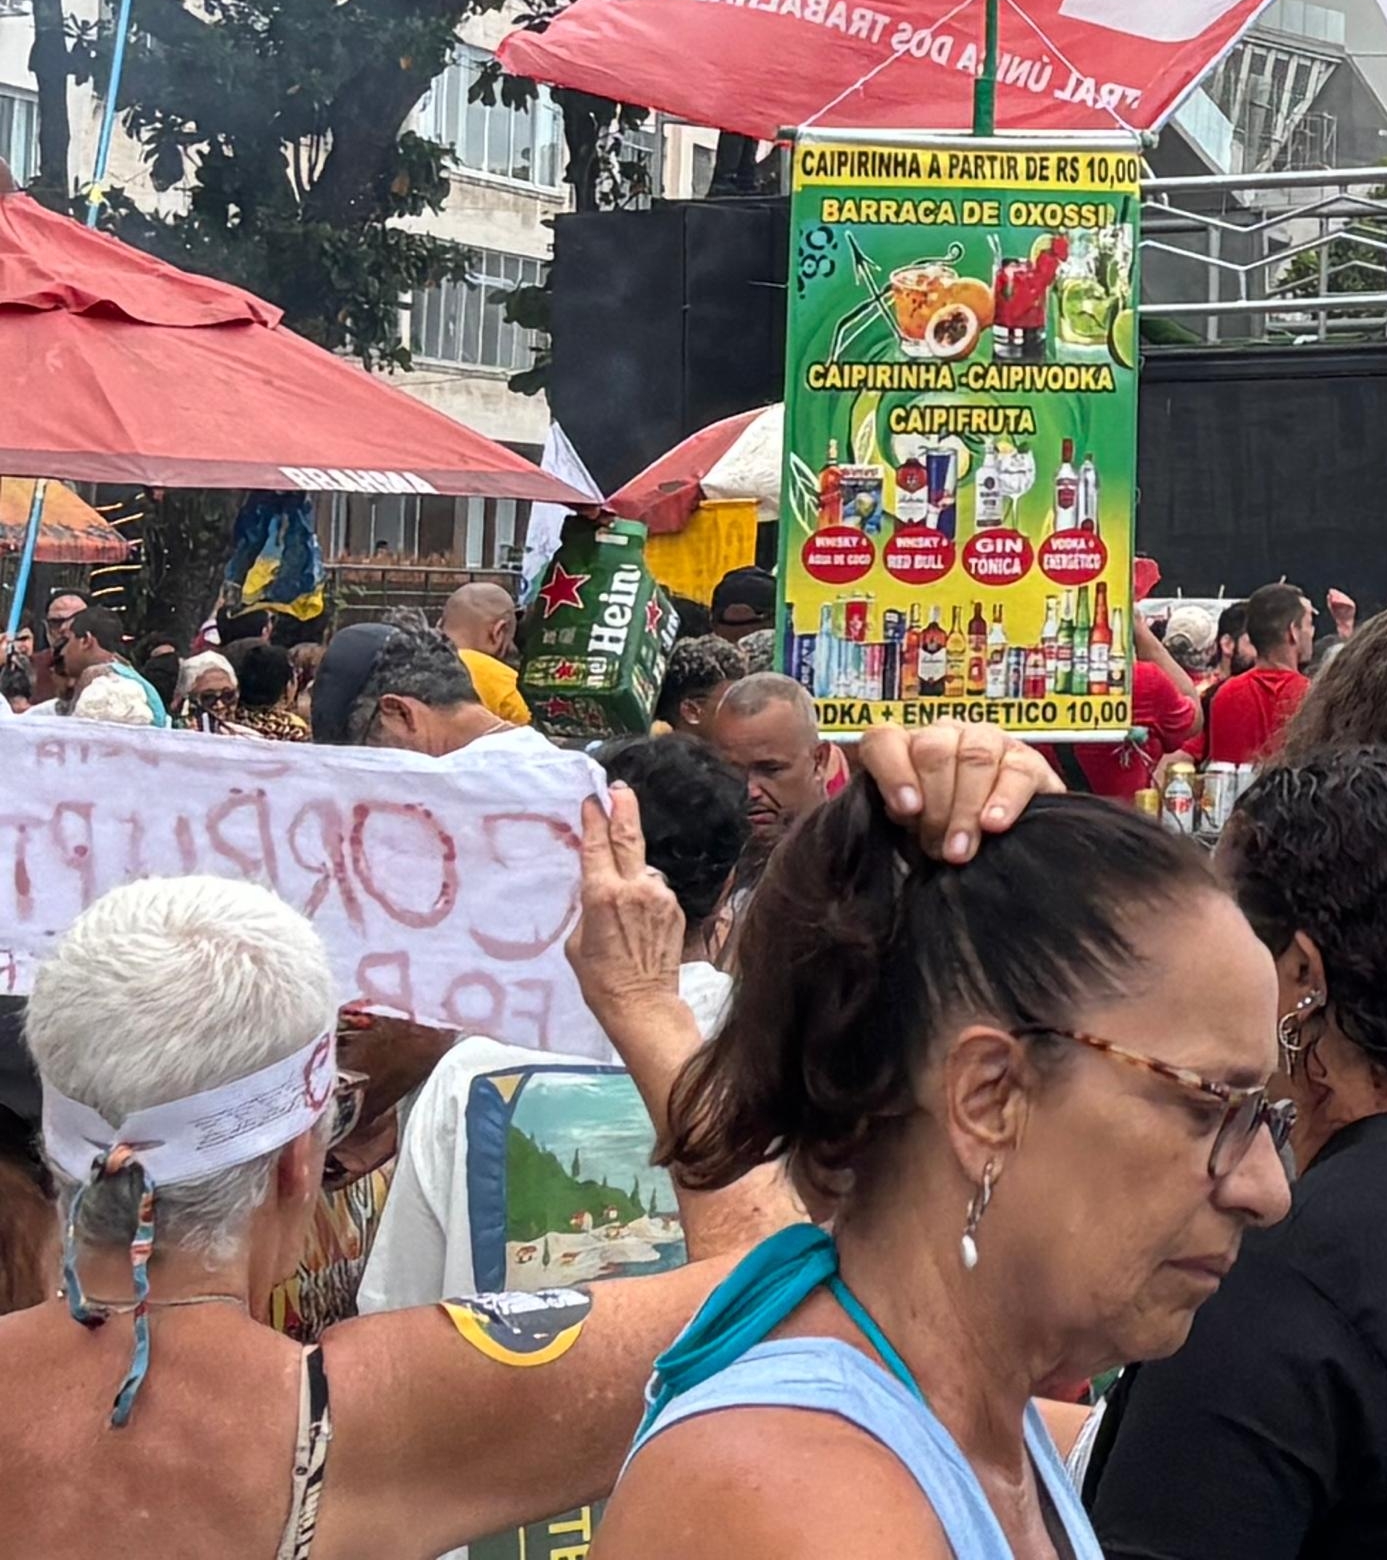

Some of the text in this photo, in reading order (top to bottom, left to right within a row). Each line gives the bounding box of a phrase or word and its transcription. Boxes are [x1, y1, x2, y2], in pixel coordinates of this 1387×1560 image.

[801, 150, 919, 180] CAIPIRINHA
[927, 155, 943, 180] A
[949, 153, 1019, 182] PARTIR
[1025, 156, 1050, 181] DE
[1086, 157, 1137, 190] 10,00
[821, 198, 1111, 228] BARRACA DE OXOSSI
[807, 362, 956, 391] CAIPIRINHA
[889, 405, 1036, 434] CAIPIFRUTA
[975, 537, 1024, 553] GIN
[1065, 700, 1128, 729] 10,00
